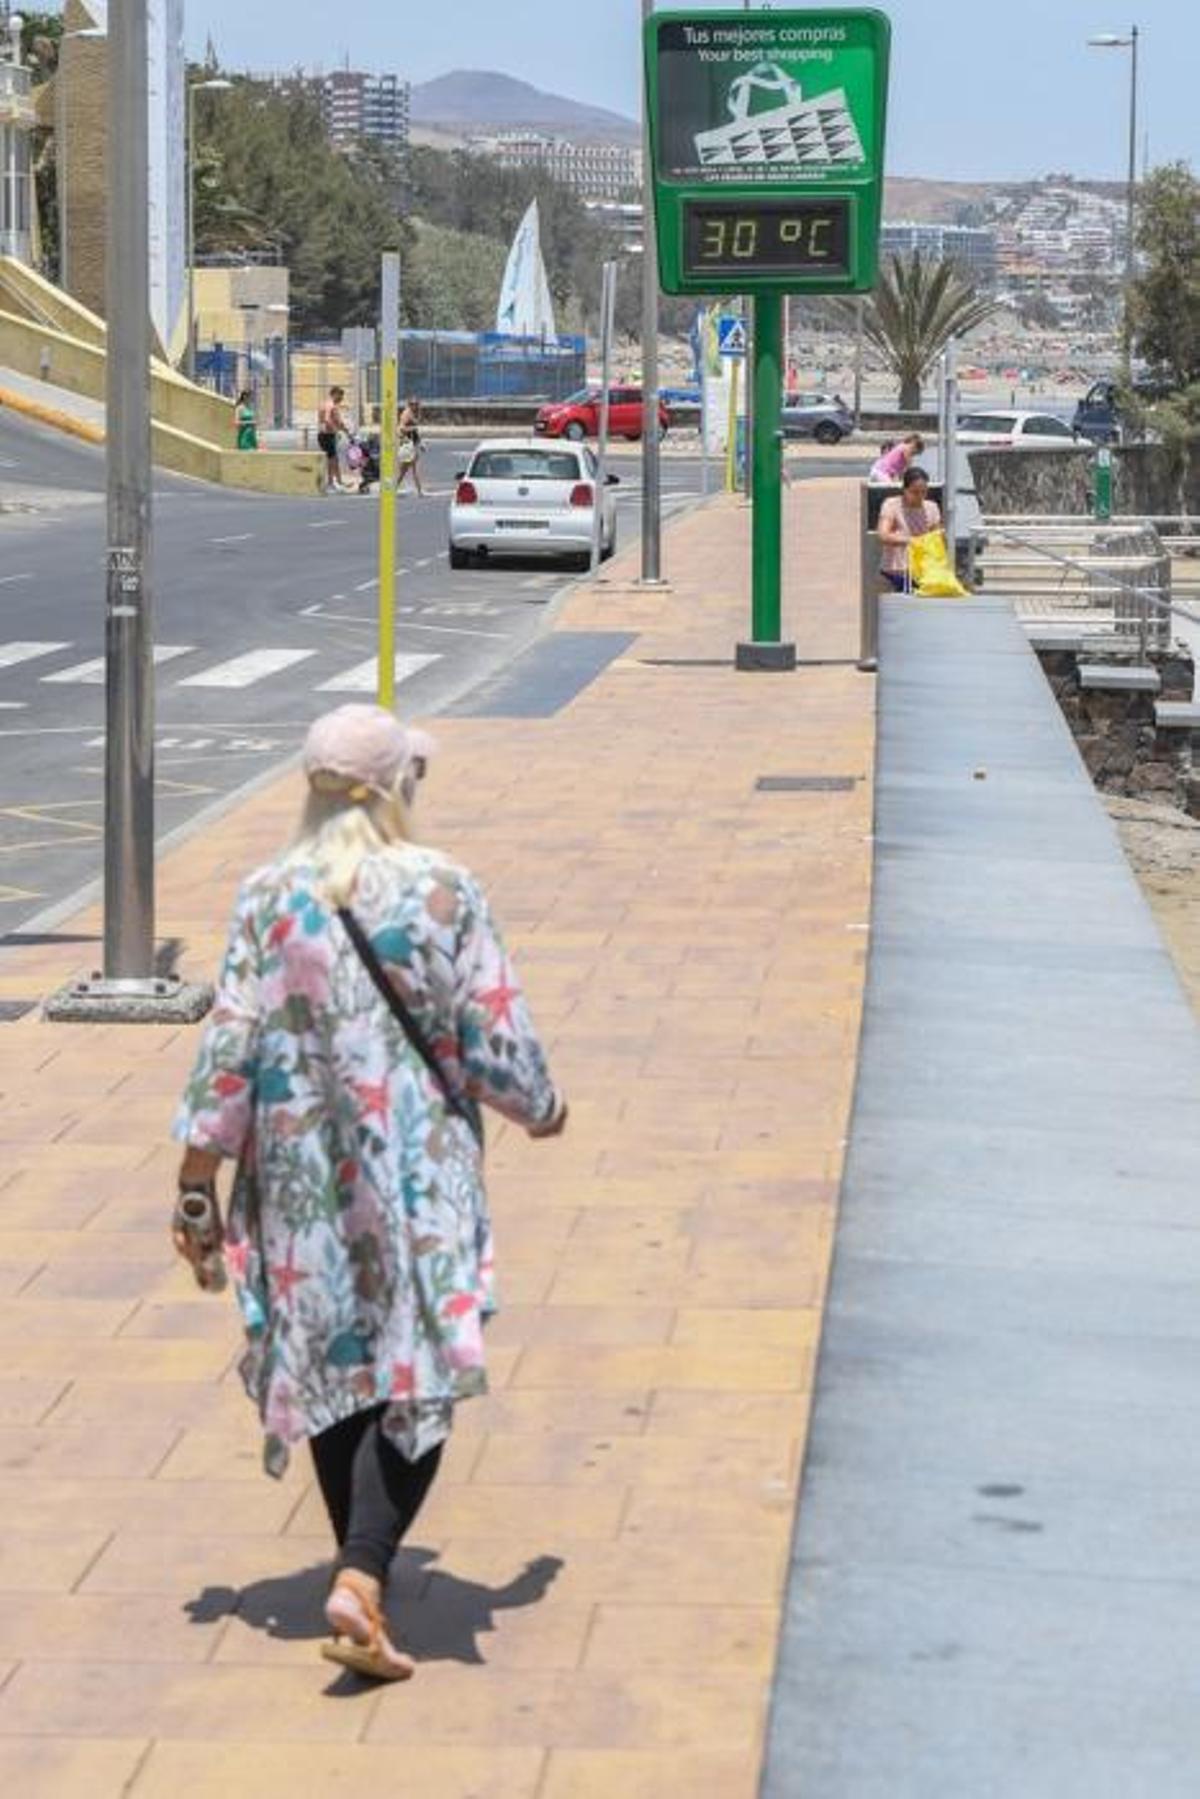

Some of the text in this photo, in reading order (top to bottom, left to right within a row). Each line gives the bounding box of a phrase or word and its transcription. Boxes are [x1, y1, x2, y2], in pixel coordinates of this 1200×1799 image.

[682, 26, 846, 46] Tus mejores compras
[698, 48, 833, 63] Your best shopping
[702, 220, 757, 257] 30
